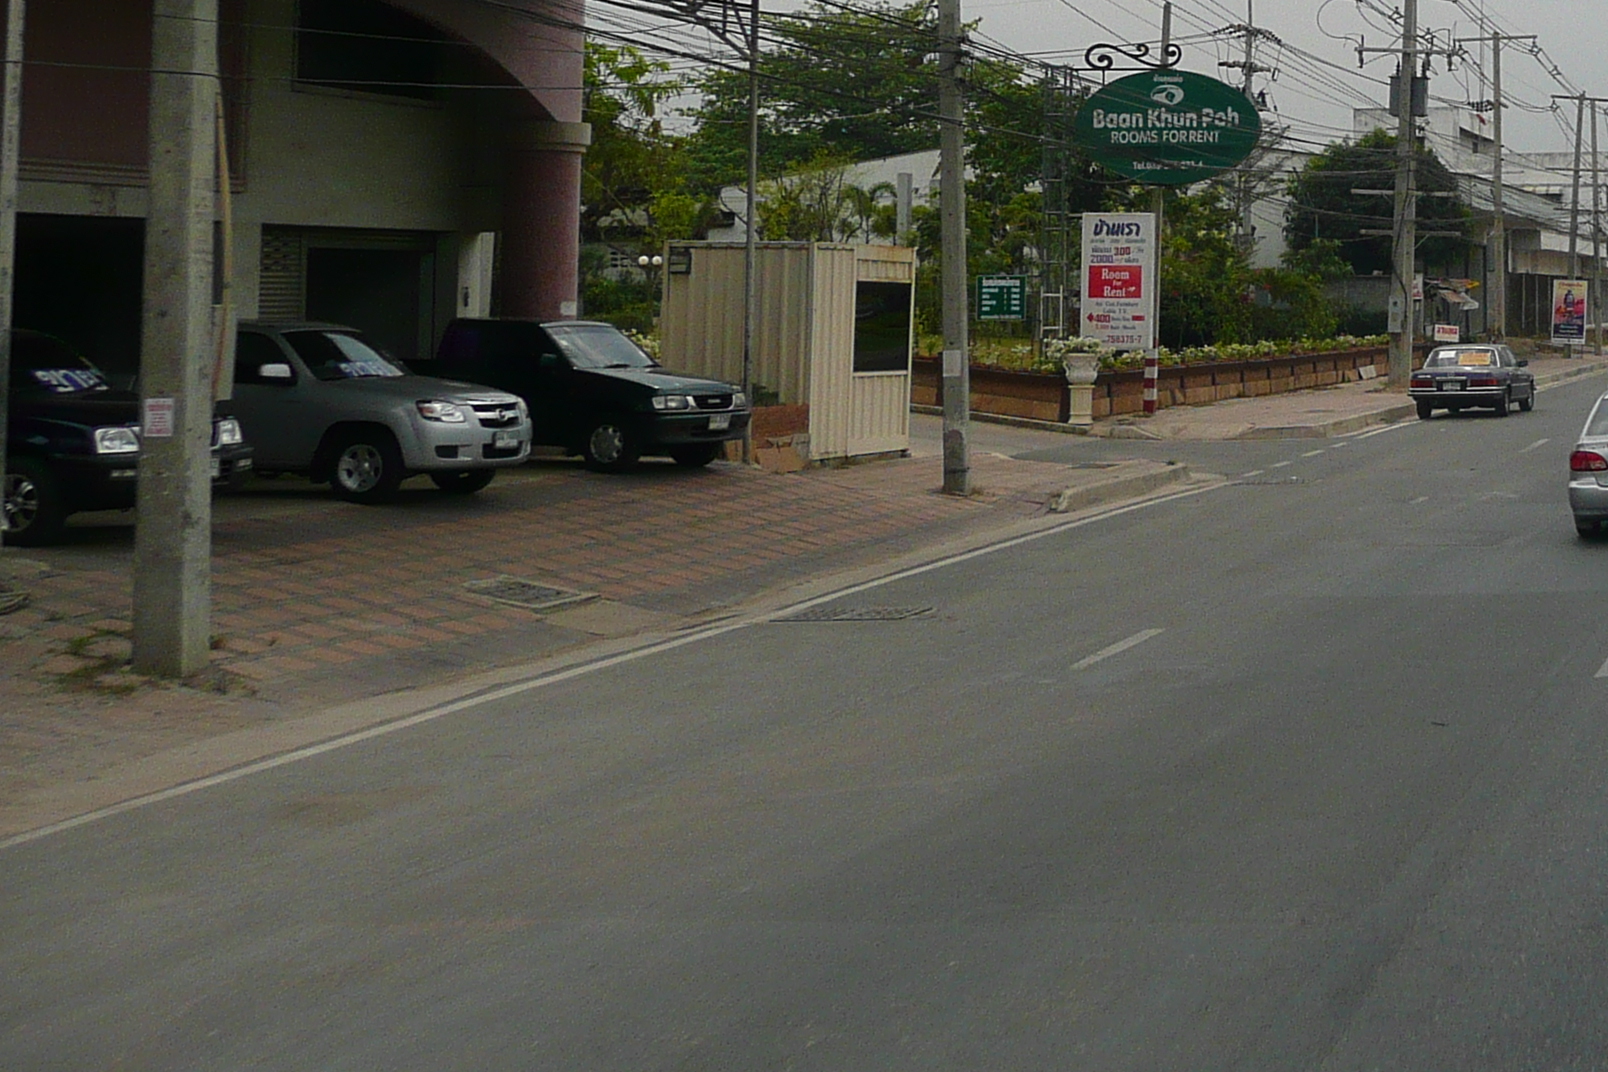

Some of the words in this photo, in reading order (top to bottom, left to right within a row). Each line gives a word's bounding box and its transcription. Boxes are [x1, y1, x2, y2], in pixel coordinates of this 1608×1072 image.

[1093, 109, 1143, 128] Baan
[1147, 107, 1197, 128] Khun
[1111, 130, 1158, 144] ROOMS
[1162, 130, 1187, 143] FOR
[1189, 130, 1220, 143] RENT
[1093, 218, 1141, 237] บ้านเรา
[1101, 268, 1130, 280] Room
[1103, 286, 1126, 297] Rent
